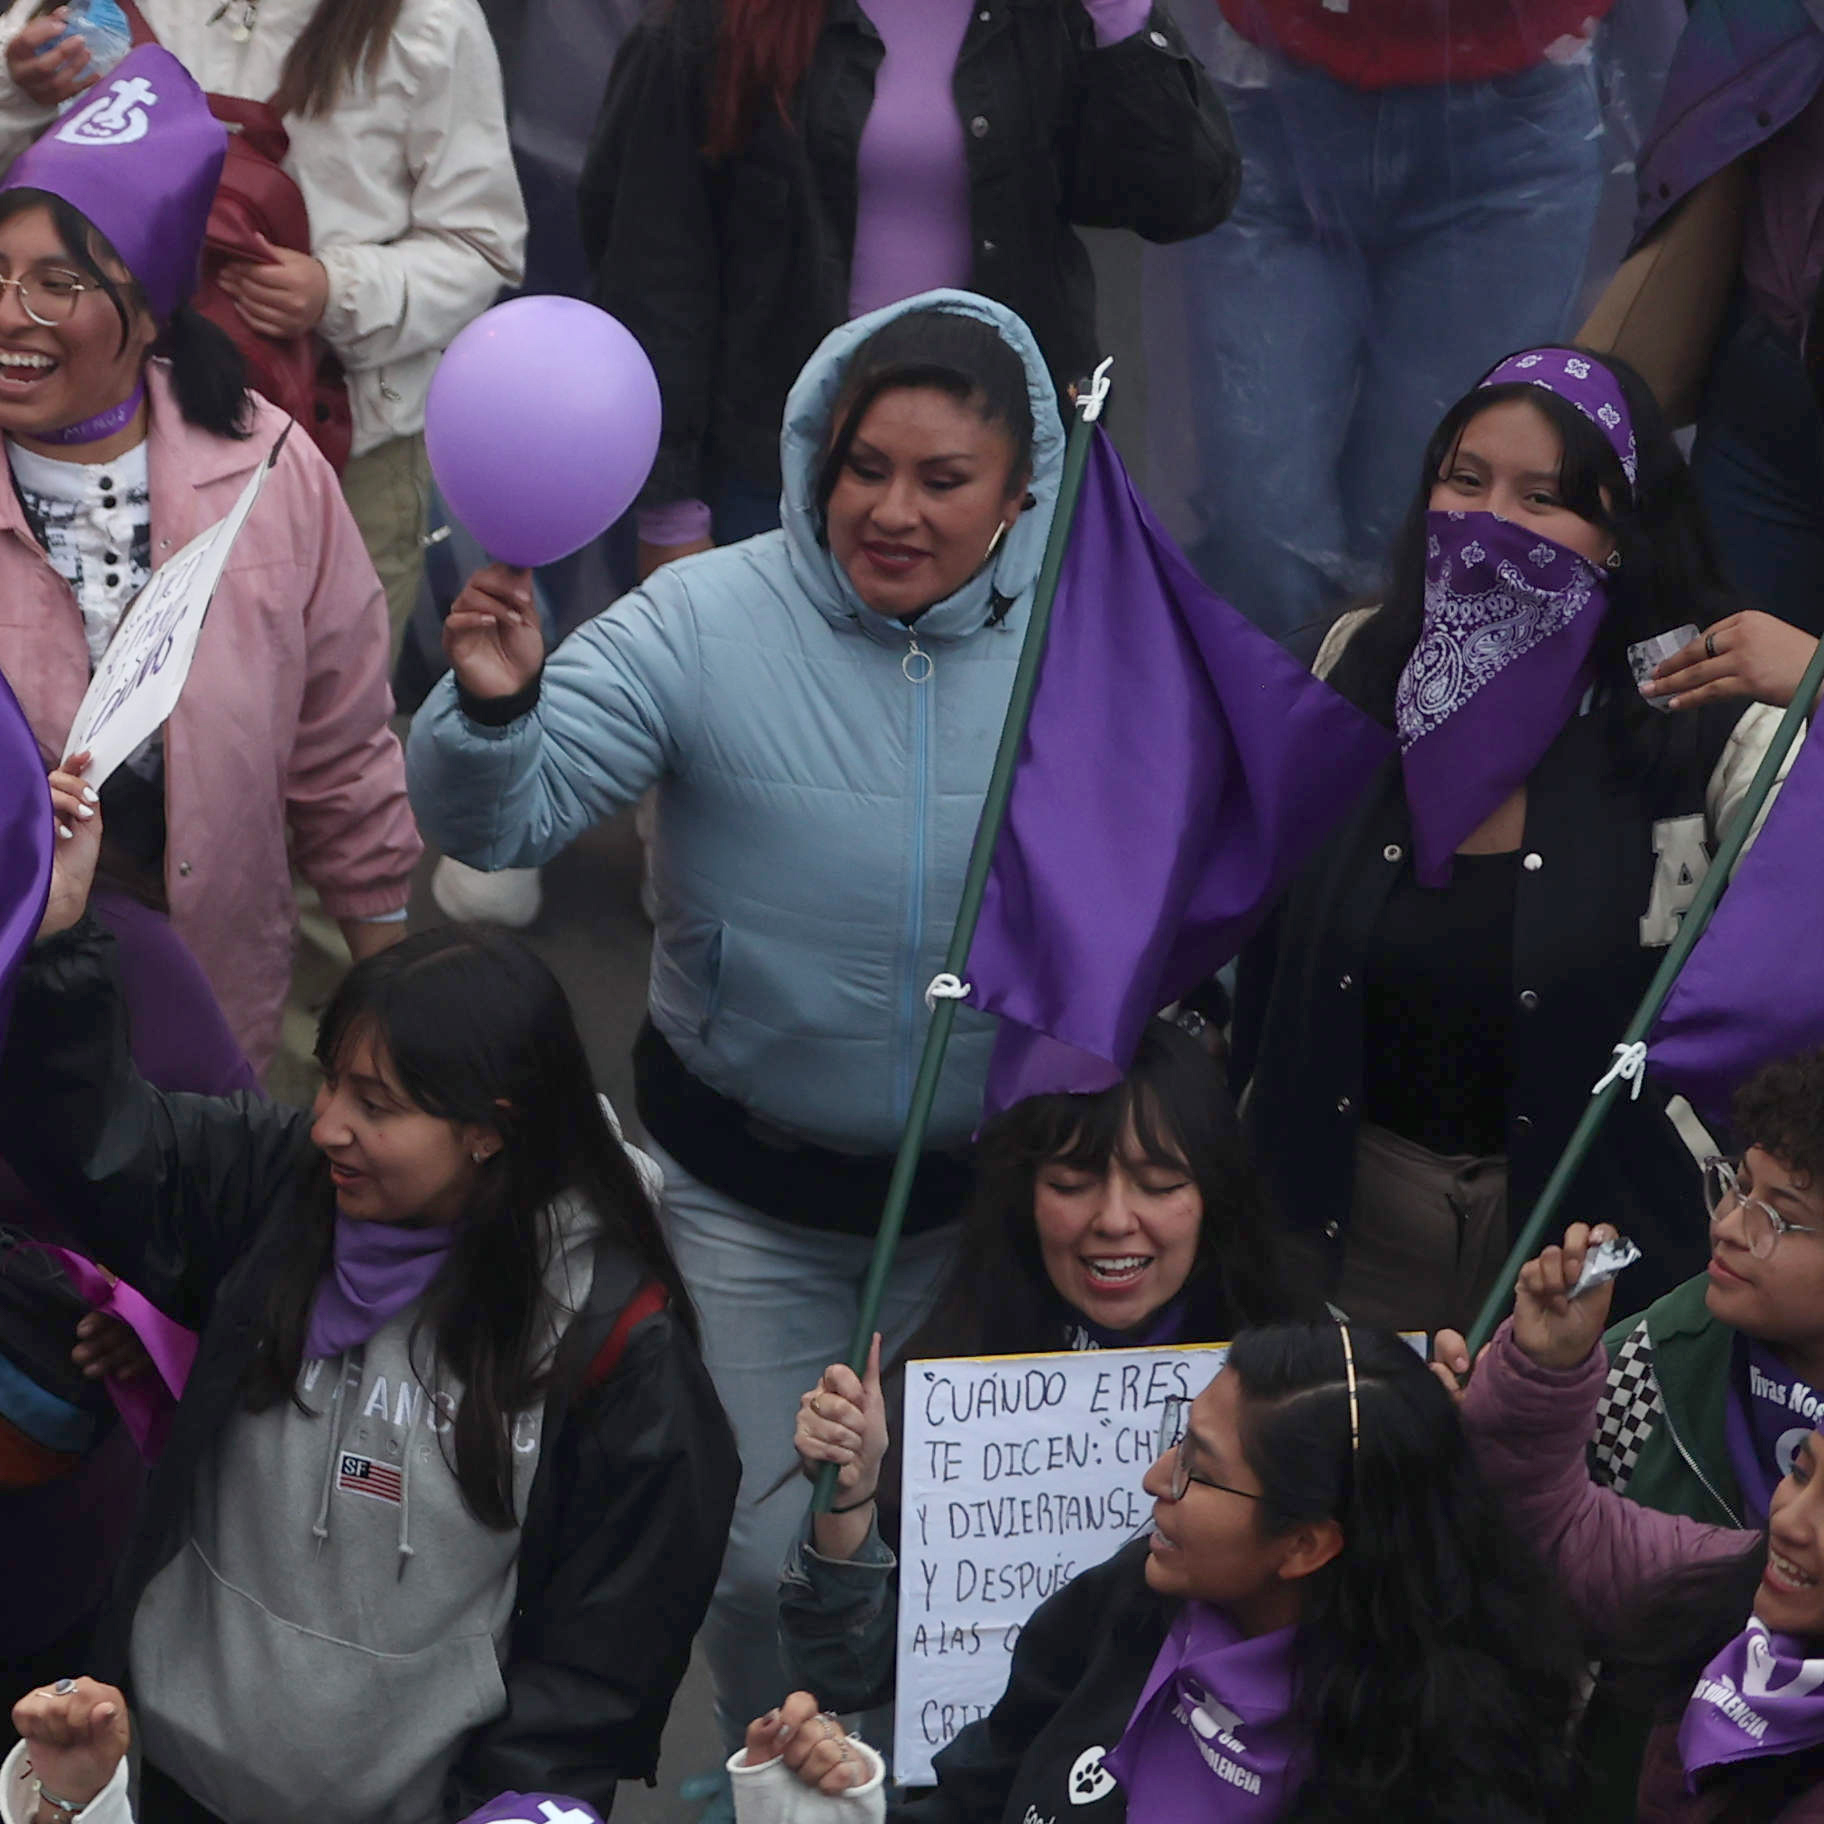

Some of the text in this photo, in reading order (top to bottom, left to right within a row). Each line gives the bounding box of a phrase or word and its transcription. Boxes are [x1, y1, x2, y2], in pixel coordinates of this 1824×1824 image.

[1090, 1361, 1191, 1414] ERES
[342, 1456, 370, 1477] SF
[924, 1440, 963, 1482] TE
[916, 1505, 930, 1547] Y
[919, 1558, 939, 1612] Y
